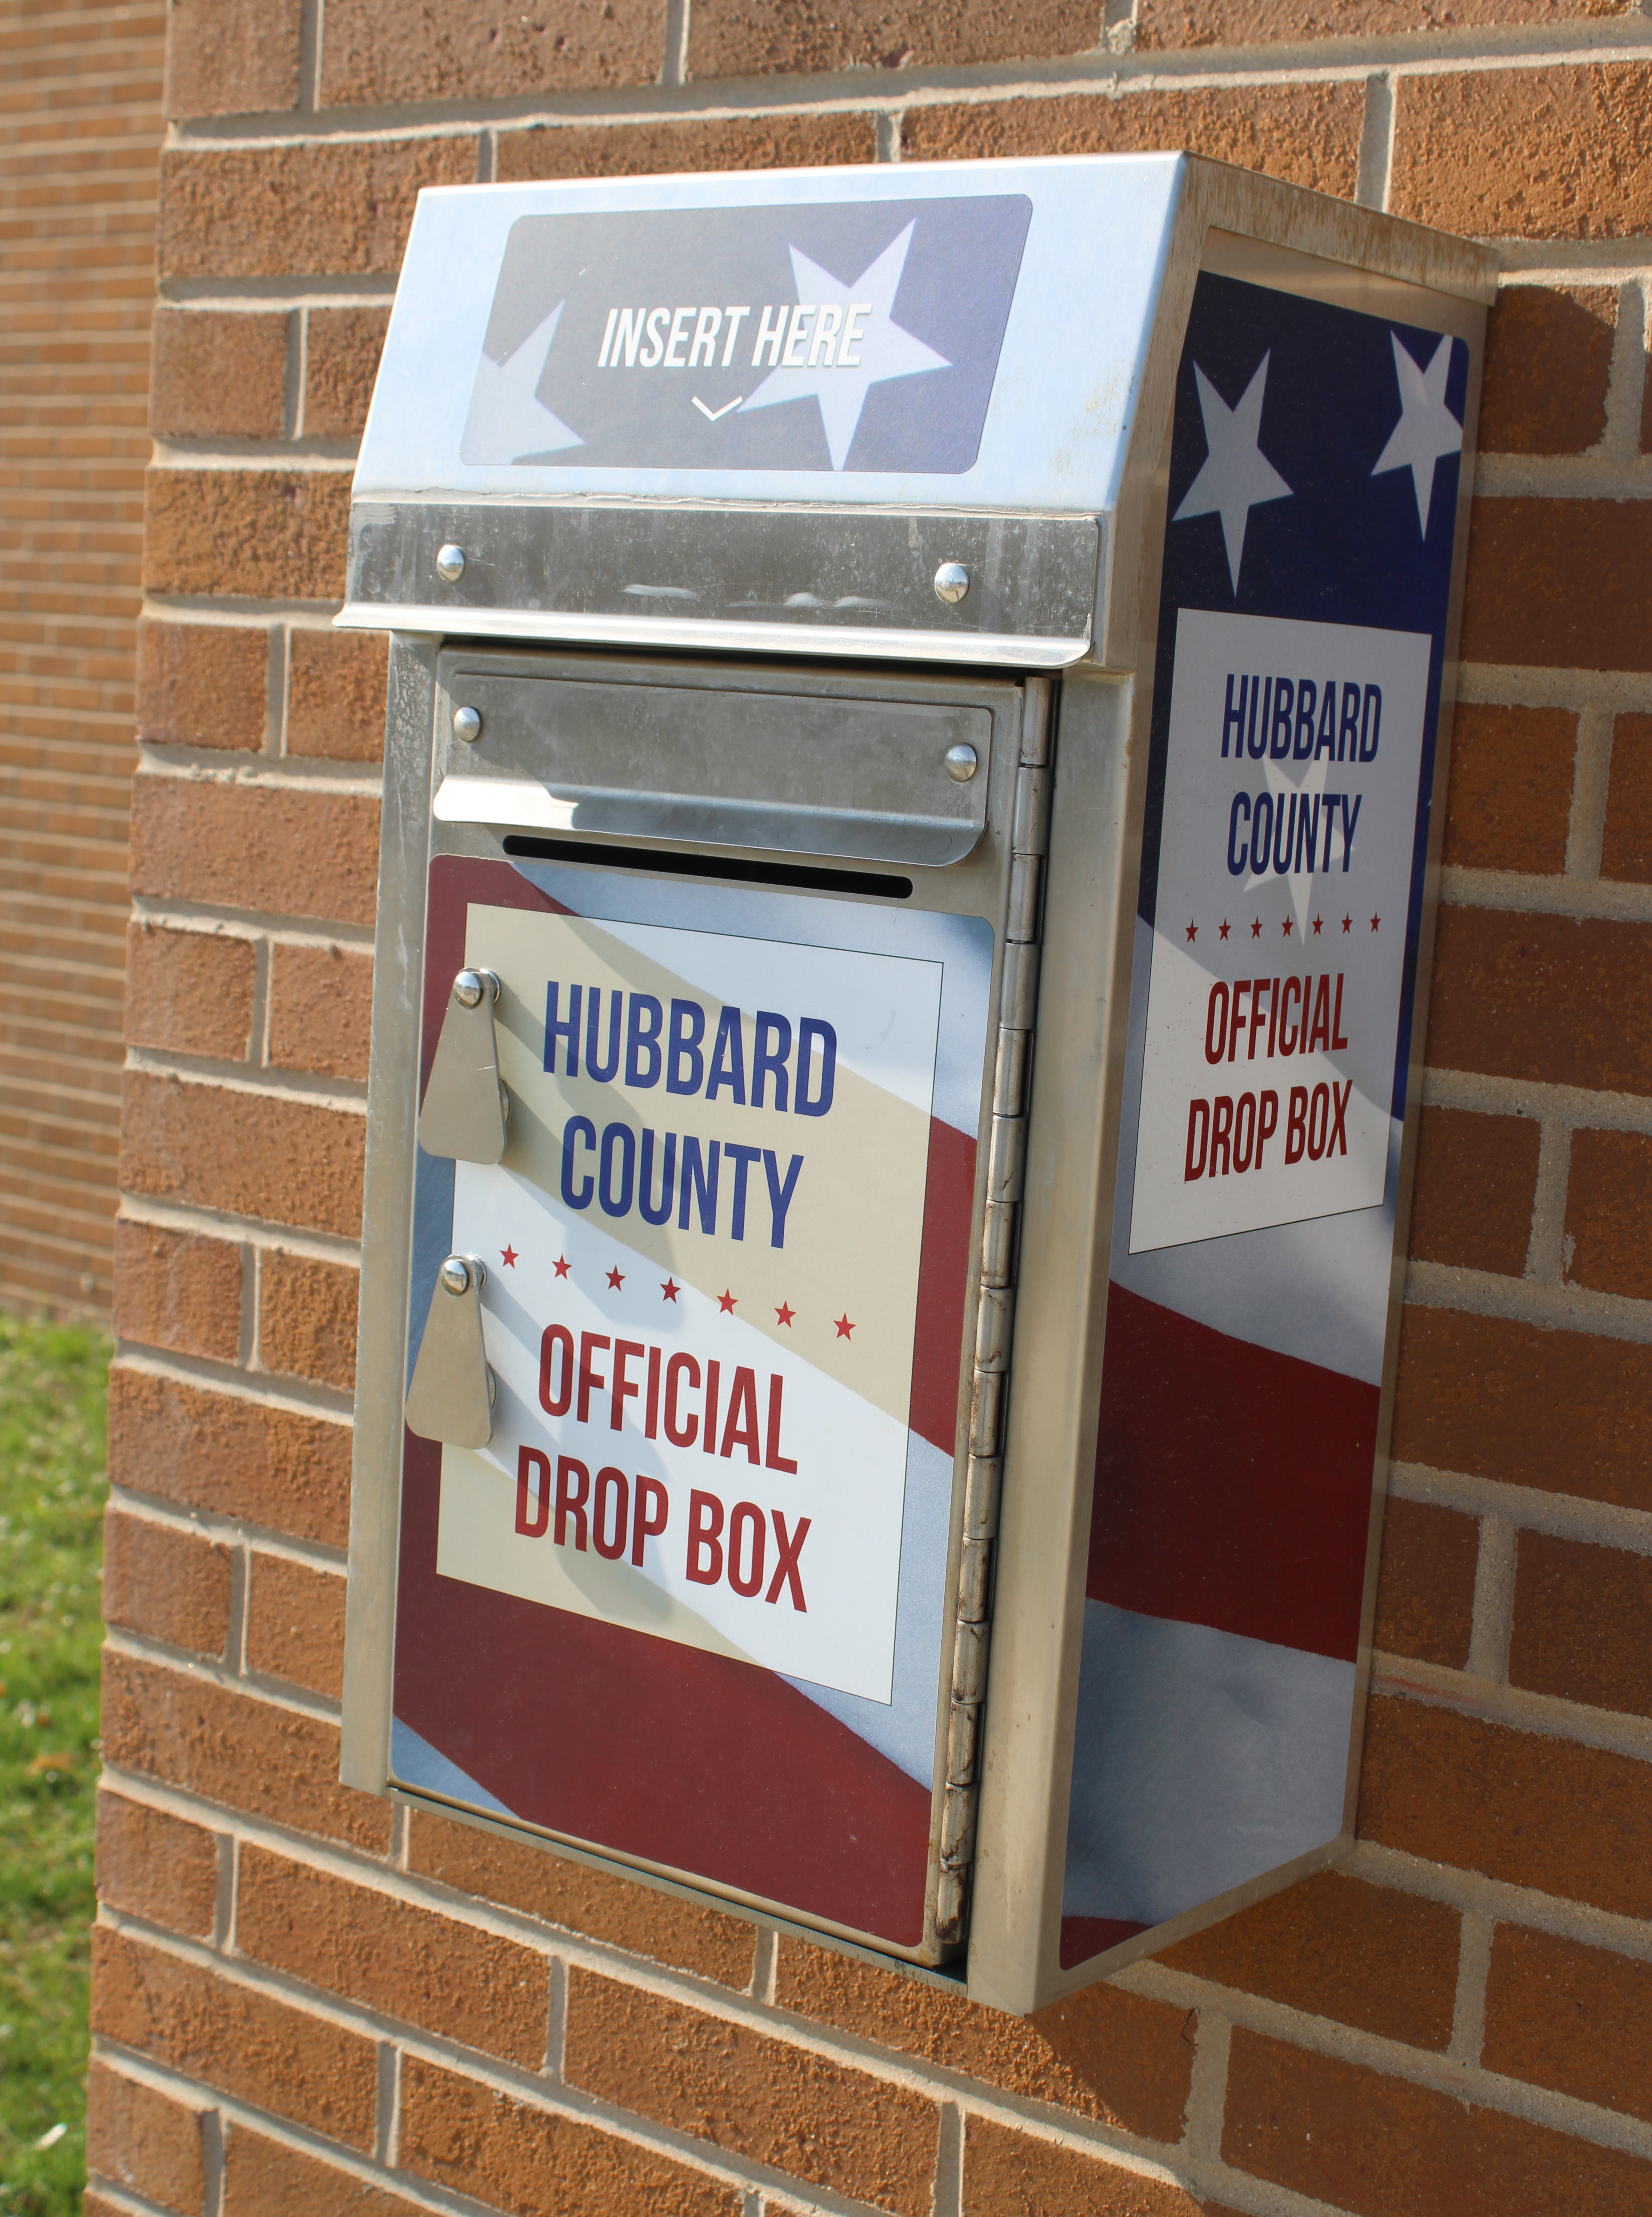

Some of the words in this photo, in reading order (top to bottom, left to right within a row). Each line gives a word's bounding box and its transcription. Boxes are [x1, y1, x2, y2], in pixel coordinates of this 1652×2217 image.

[598, 305, 750, 368] INSERT
[751, 303, 872, 367] HERE
[1221, 674, 1382, 763] HUBBARD
[1227, 791, 1362, 875] COUNTY
[544, 981, 837, 1117] HUBBARD
[1205, 973, 1348, 1065] OFFICIAL
[561, 1115, 804, 1248] COUNTY
[1184, 1090, 1278, 1182] DROP
[1285, 1080, 1353, 1165] BOX
[539, 1324, 798, 1474] OFFICIAL
[515, 1445, 669, 1567] DROP
[685, 1489, 812, 1613] BOX
